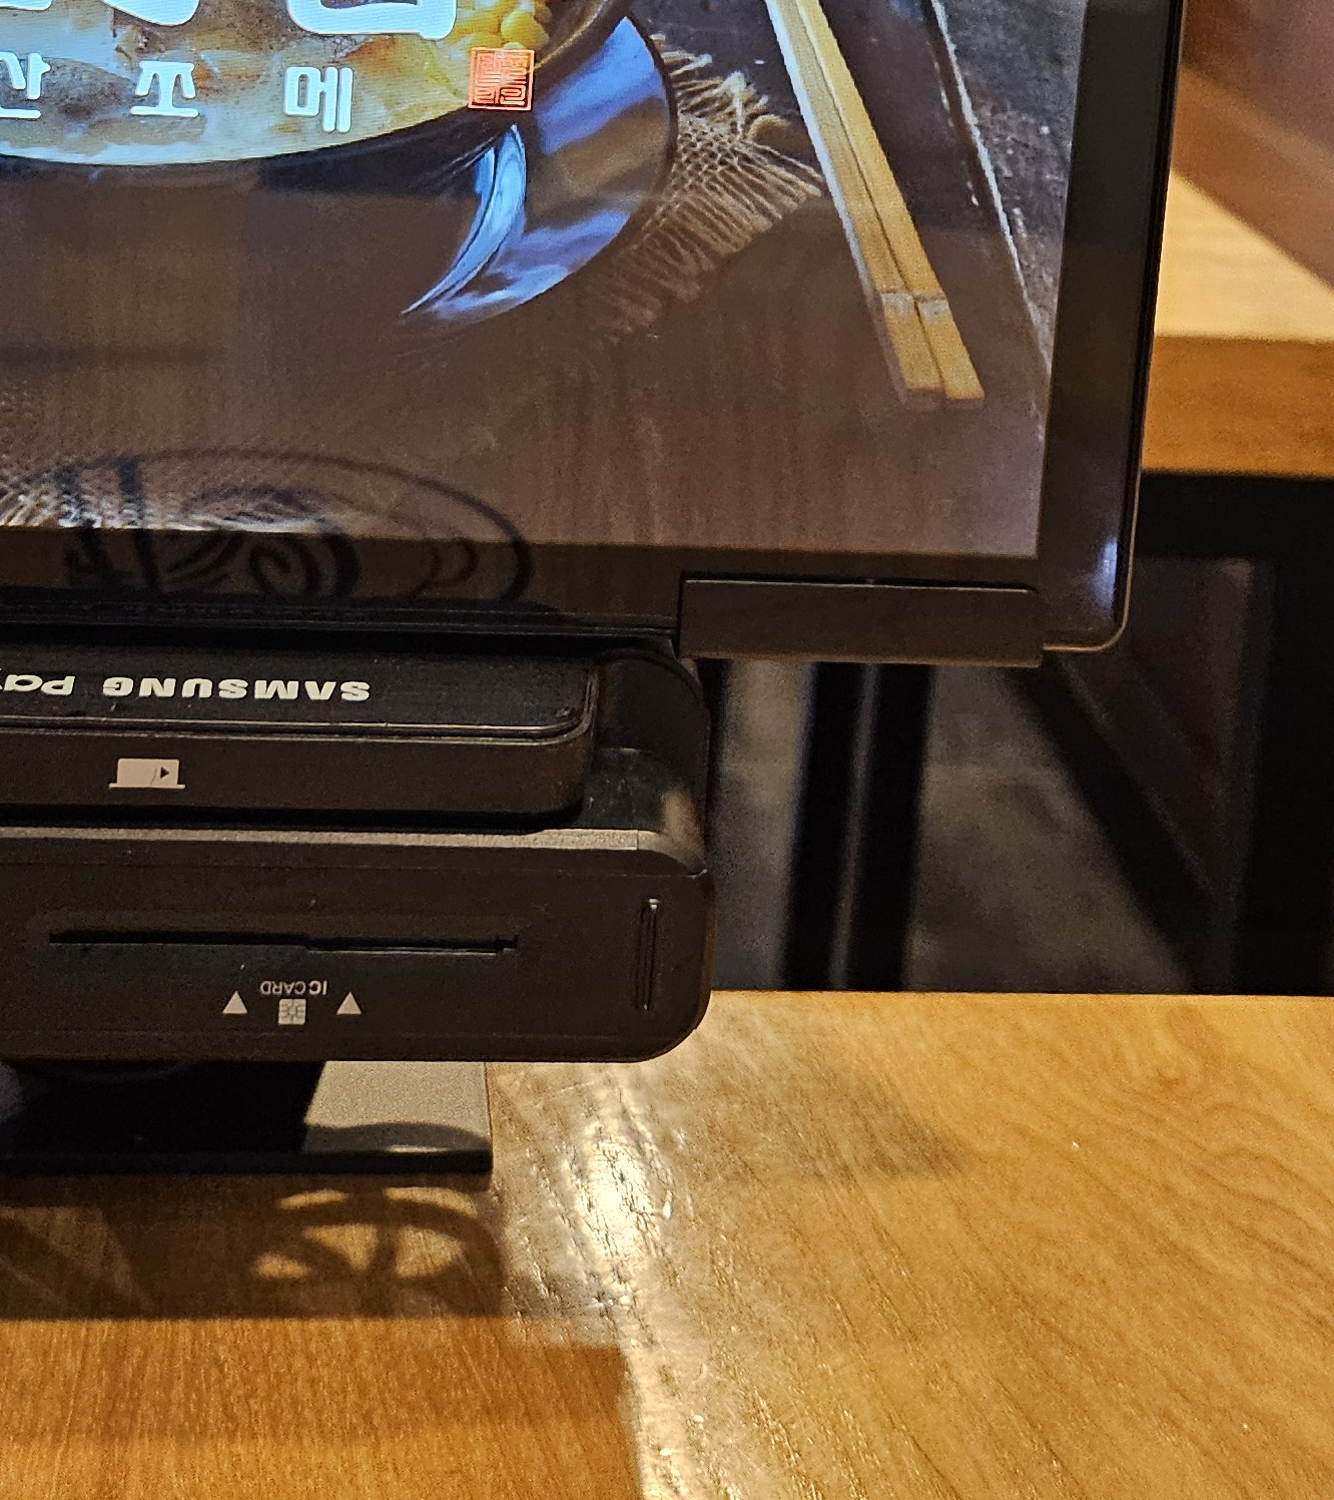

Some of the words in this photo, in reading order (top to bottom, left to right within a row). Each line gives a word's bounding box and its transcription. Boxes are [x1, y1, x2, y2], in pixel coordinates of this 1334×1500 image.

[103, 677, 371, 702] SAMSUNG
[260, 980, 307, 995] CARD
[308, 980, 328, 995] IC
